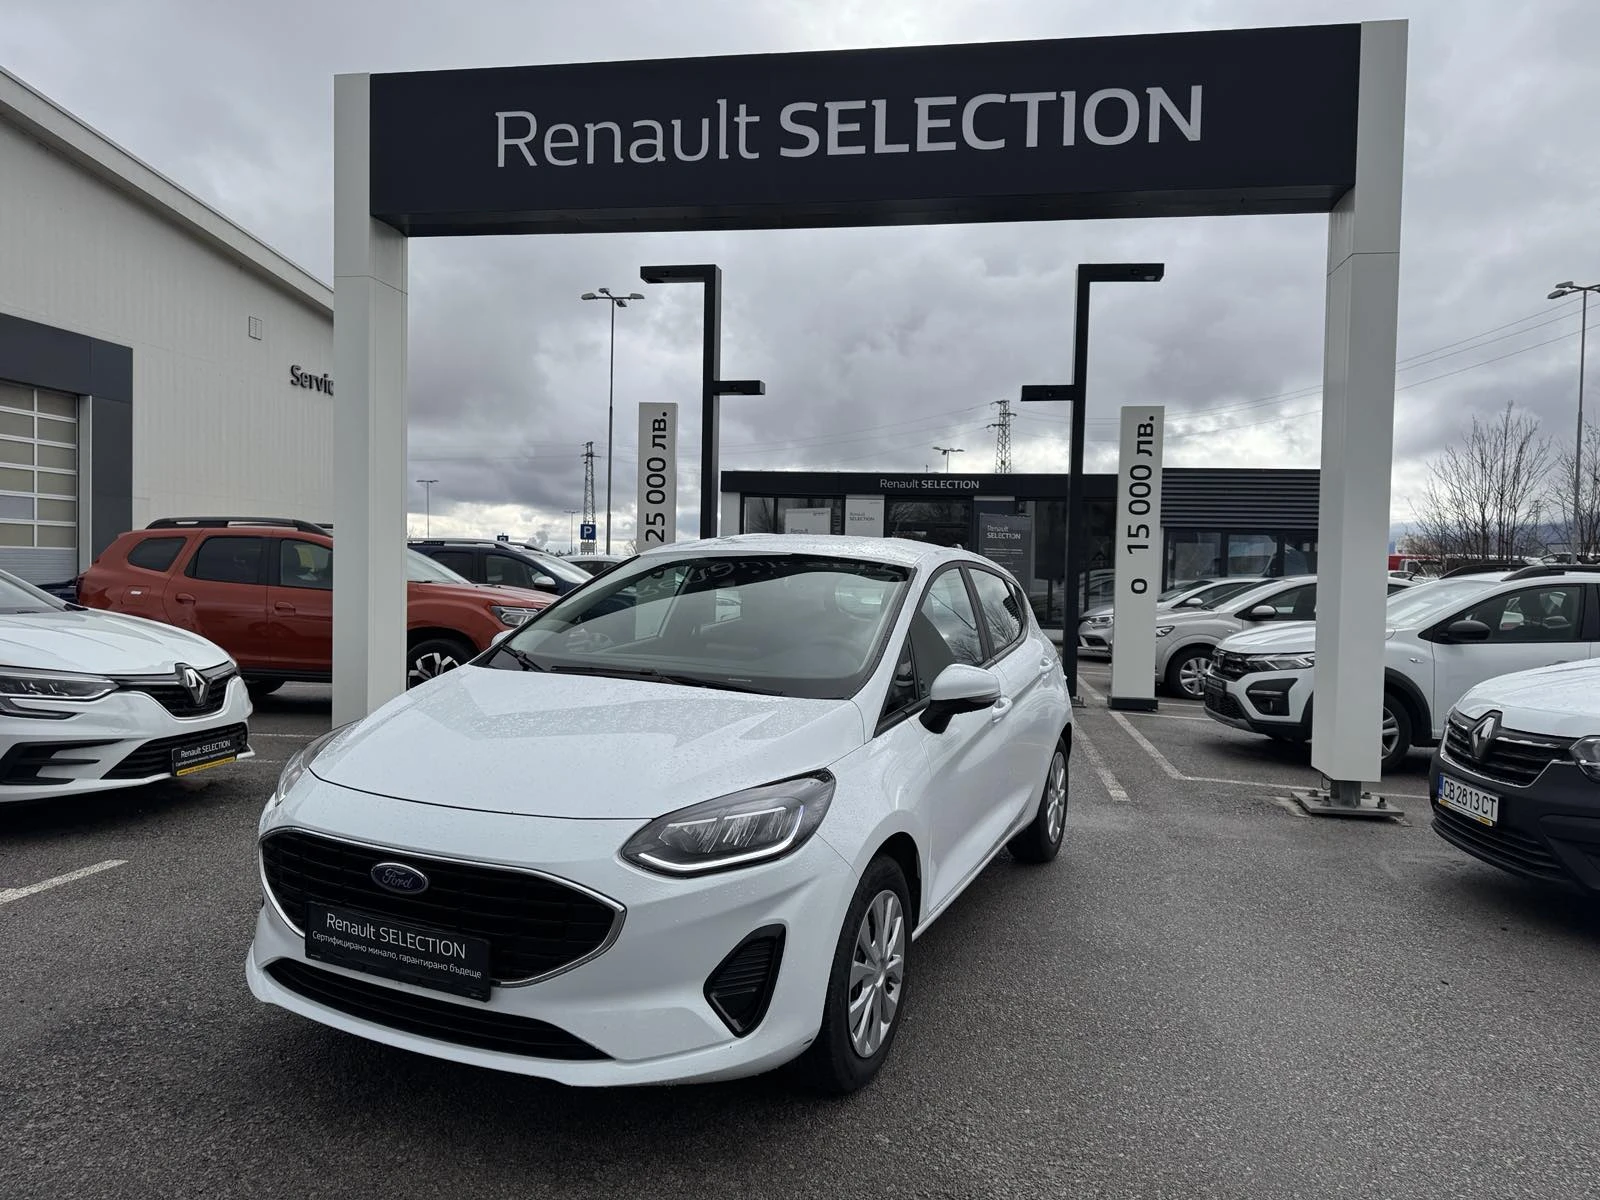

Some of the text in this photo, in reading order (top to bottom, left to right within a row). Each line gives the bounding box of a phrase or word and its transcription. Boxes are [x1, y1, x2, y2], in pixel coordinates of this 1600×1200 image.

[495, 85, 1203, 167] Renault SELECTION
[1136, 415, 1155, 457] лв.
[645, 411, 668, 543] 25 000 лв.
[880, 478, 980, 489] Renault SELECTION
[1128, 464, 1152, 515] 000
[583, 526, 593, 539] P
[986, 532, 1021, 540] SELECTION
[1126, 524, 1150, 554] 15
[180, 746, 201, 759] Renault
[201, 740, 231, 754] SELECTION
[381, 867, 414, 889] Ford
[326, 912, 467, 960] Renault SELECTION
[312, 930, 482, 980] Сертифицирано минало, гарантирано бъдеще
